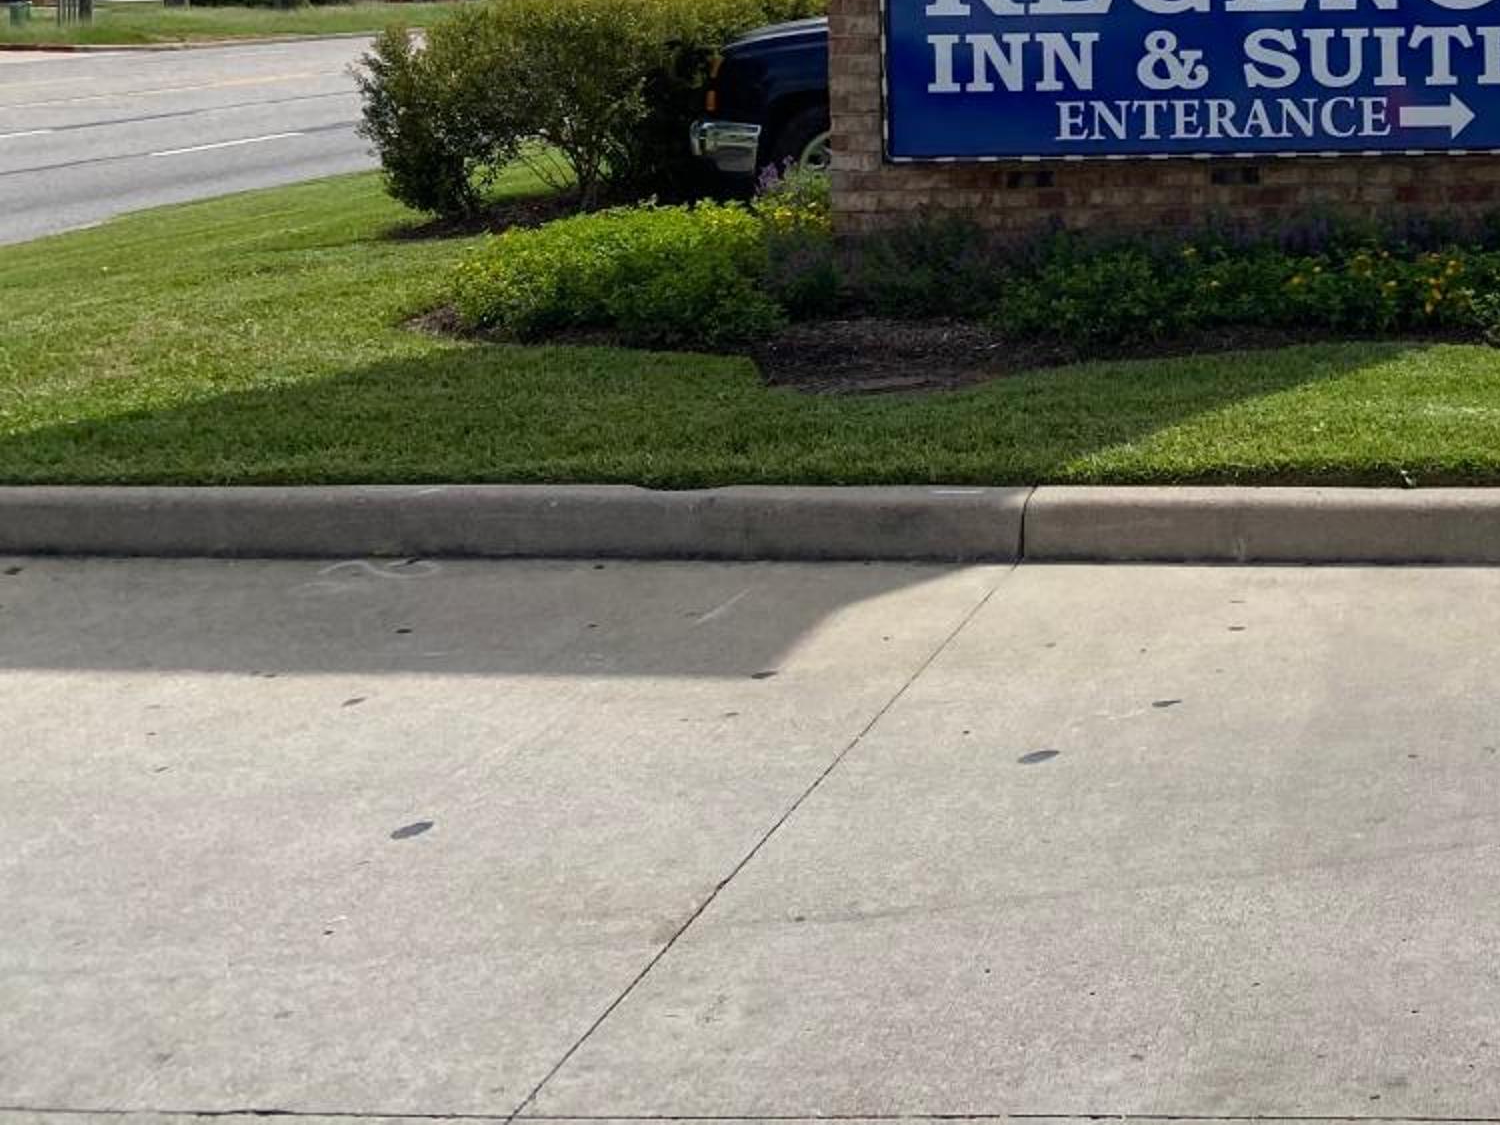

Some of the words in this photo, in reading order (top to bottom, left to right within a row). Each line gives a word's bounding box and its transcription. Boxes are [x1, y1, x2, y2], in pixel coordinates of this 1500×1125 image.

[926, 31, 1099, 94] INN
[1136, 29, 1210, 91] &
[1055, 96, 1392, 141] ENTERANCE
